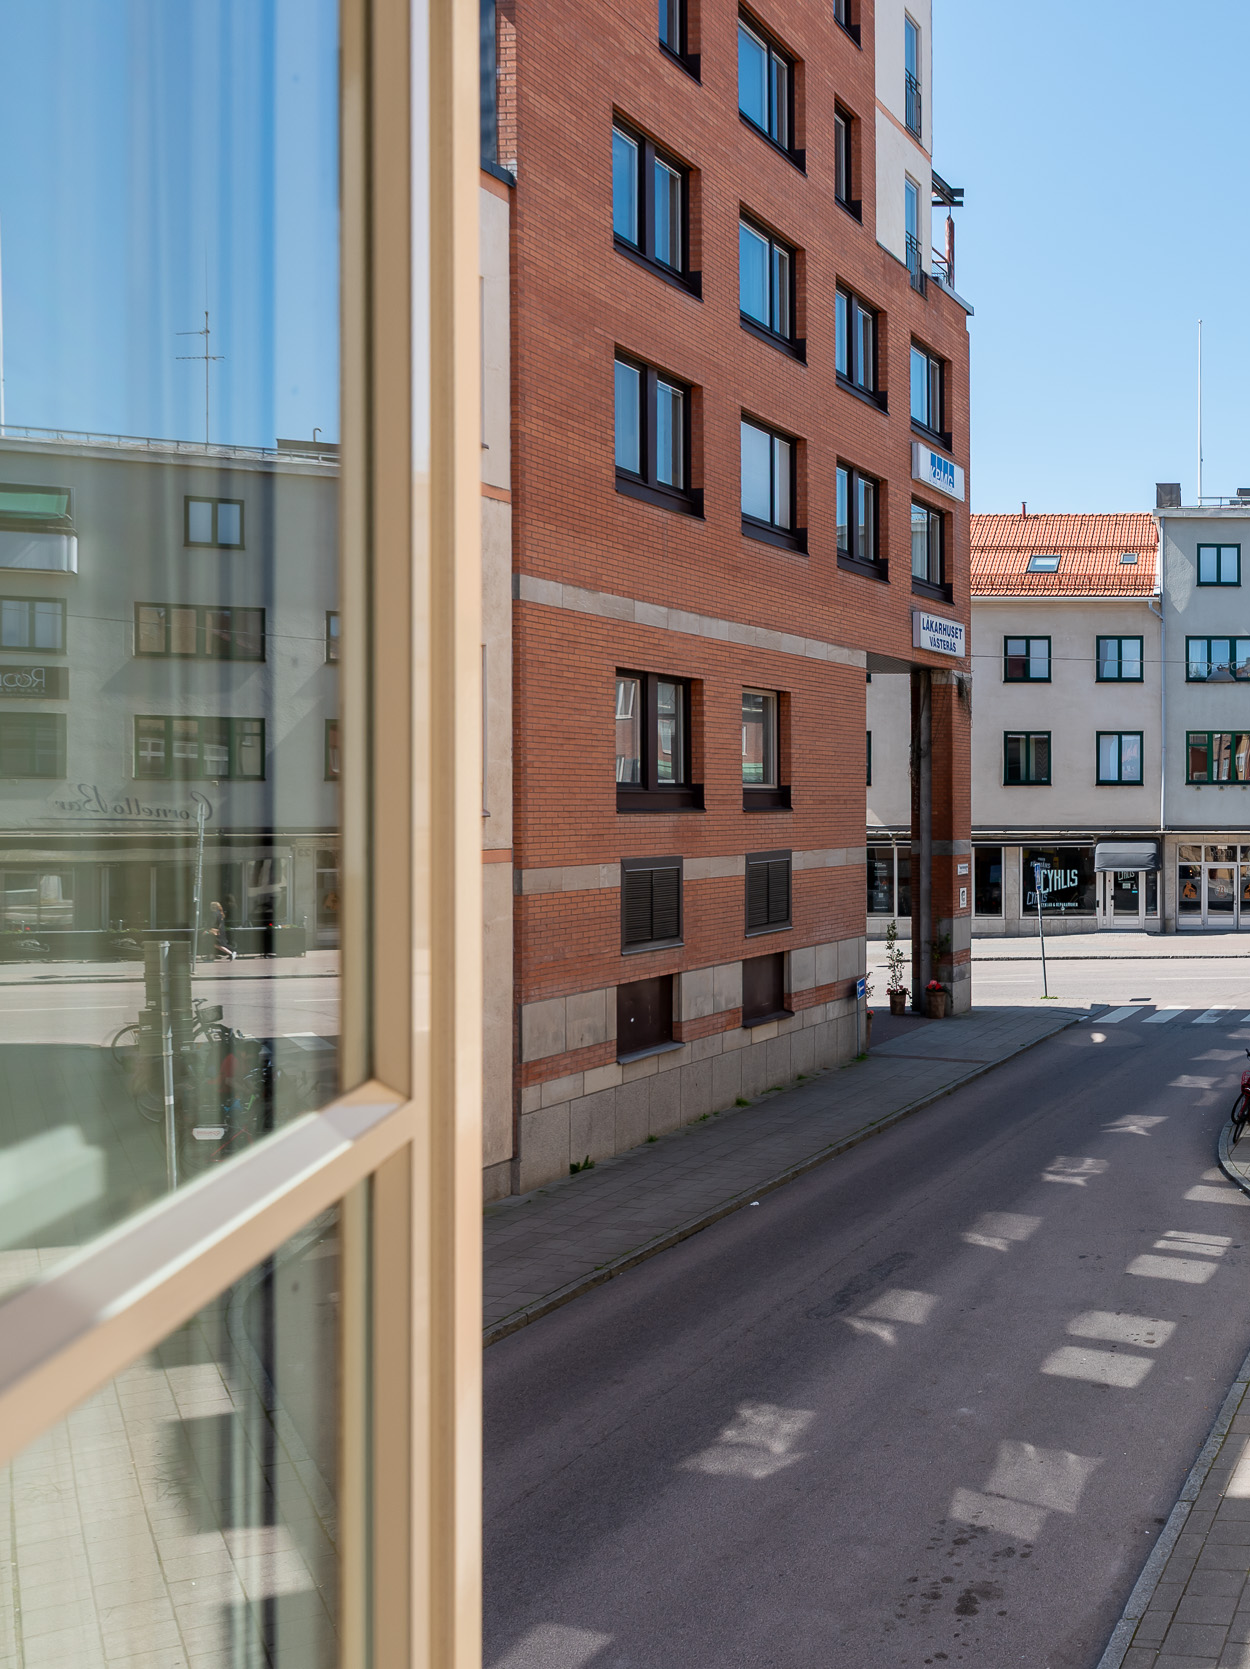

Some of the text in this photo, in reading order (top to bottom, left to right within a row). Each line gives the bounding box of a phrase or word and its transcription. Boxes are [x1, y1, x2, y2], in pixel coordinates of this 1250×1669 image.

[929, 464, 955, 492] KPMG
[922, 615, 962, 640] LÄKARHUSET
[929, 634, 957, 652] VÄSTERÅS
[1041, 869, 1078, 894] CYKLIS
